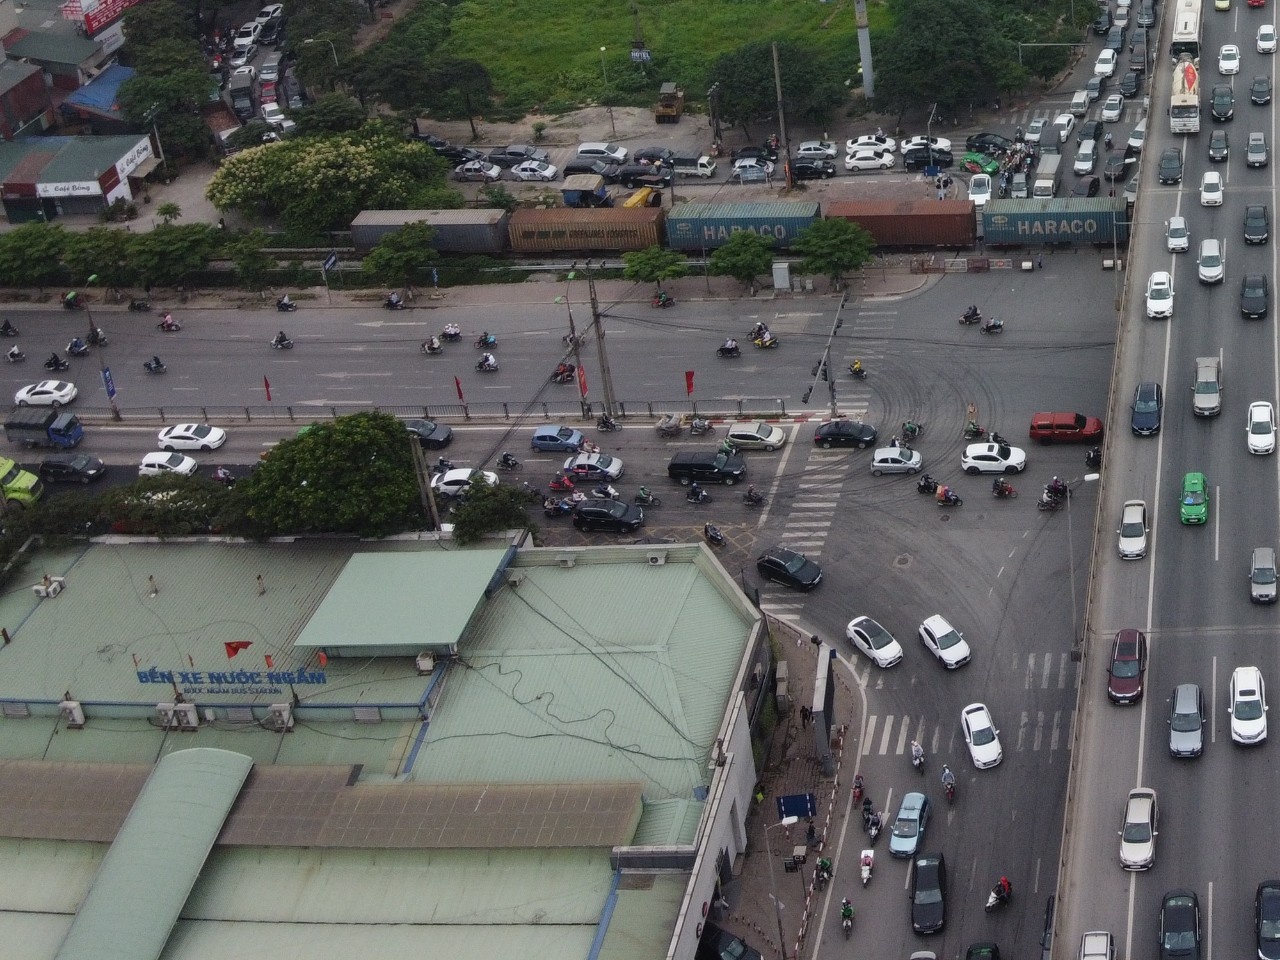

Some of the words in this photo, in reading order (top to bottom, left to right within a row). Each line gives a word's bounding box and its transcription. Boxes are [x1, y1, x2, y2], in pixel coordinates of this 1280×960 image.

[1018, 219, 1096, 234] HARACO
[137, 666, 173, 683] BẾN
[178, 672, 203, 684] XE
[208, 669, 262, 684] NƯỚC
